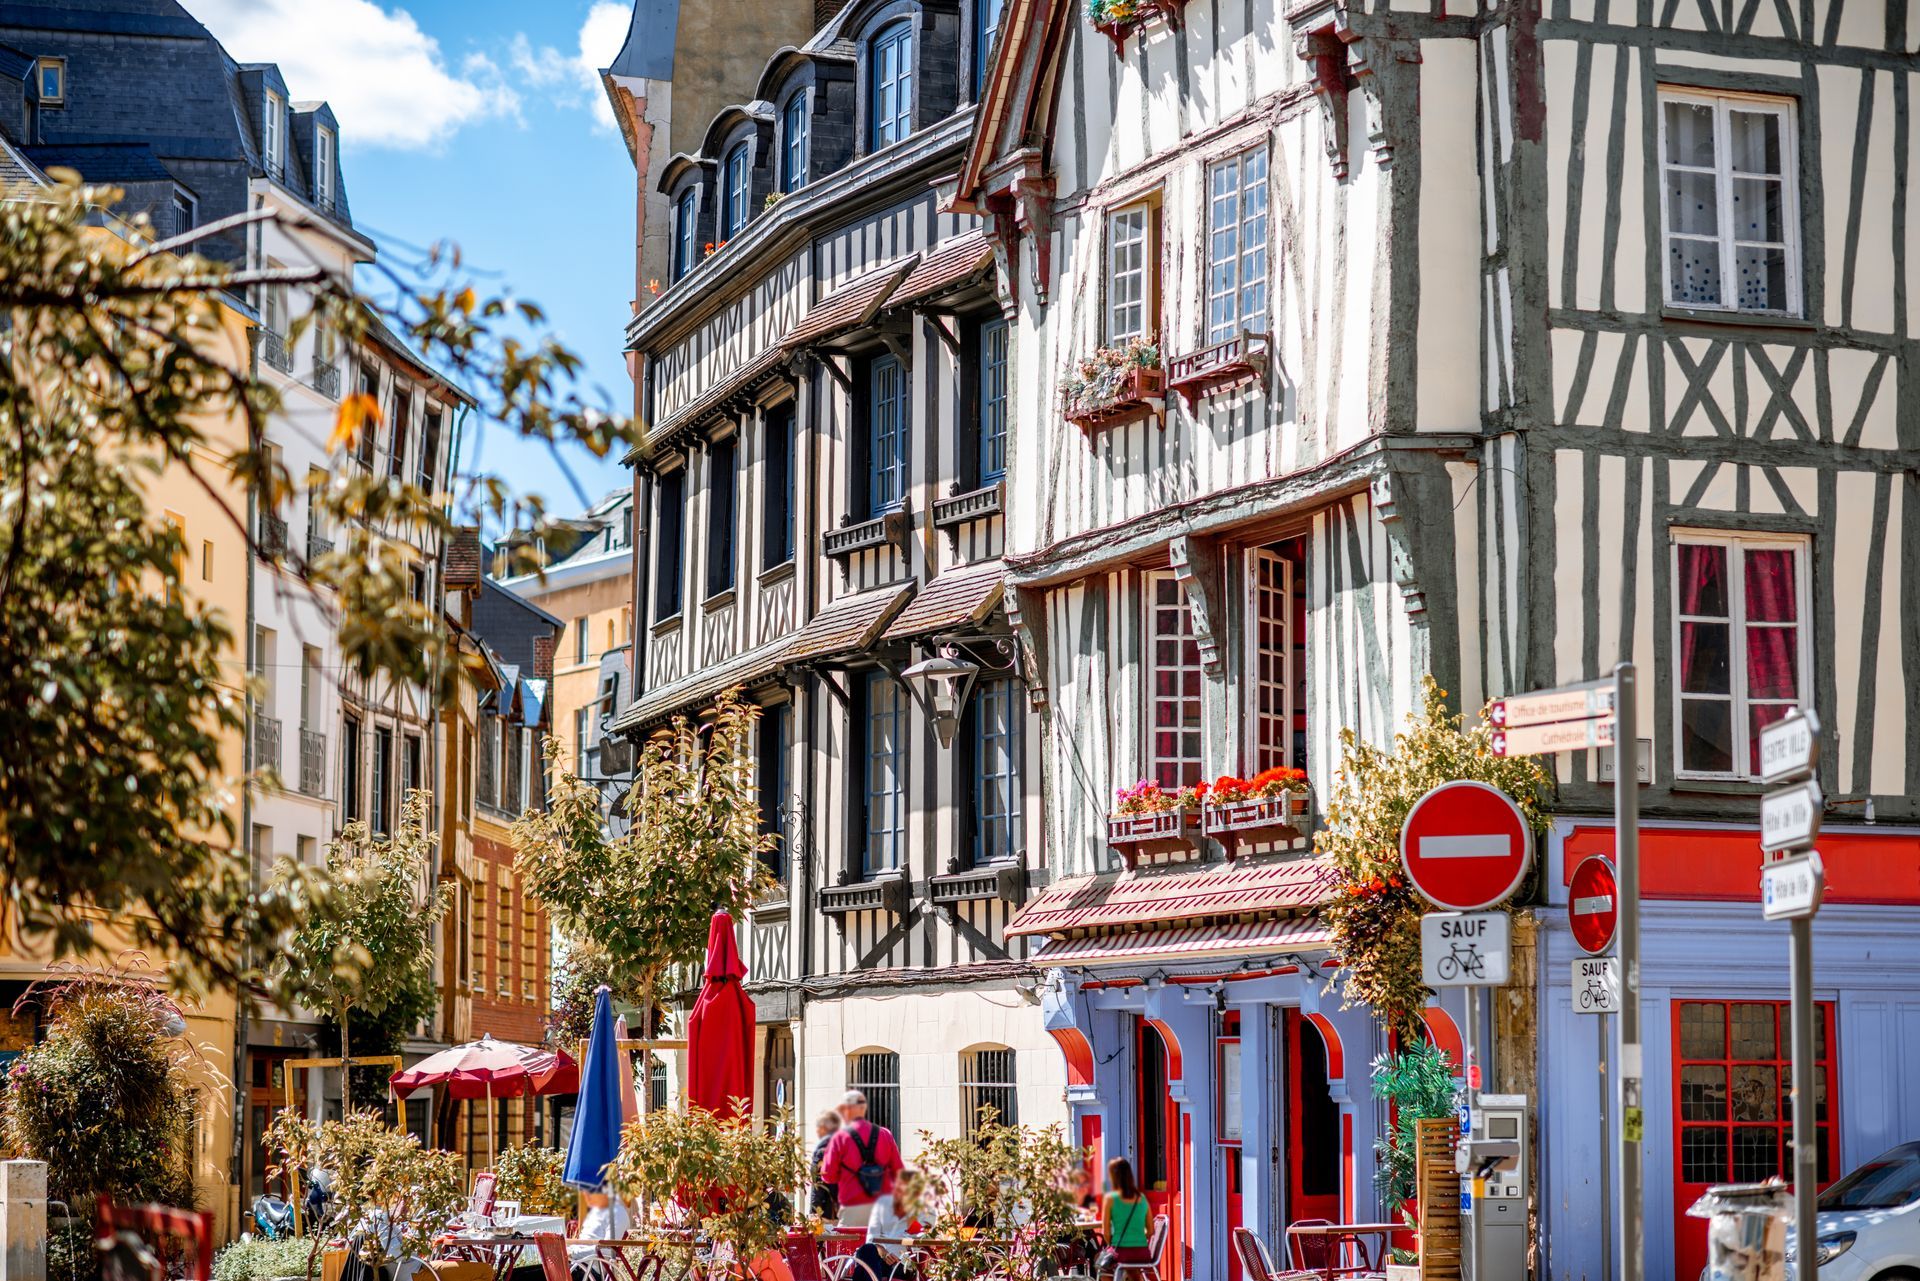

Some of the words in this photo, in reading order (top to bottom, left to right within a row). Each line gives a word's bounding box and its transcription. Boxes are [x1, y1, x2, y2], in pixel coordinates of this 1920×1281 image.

[1513, 704, 1535, 718] Office
[1538, 703, 1547, 715] de
[1549, 700, 1585, 714] tourisme
[1441, 919, 1488, 938] SAUF
[1582, 962, 1608, 977] SAUF
